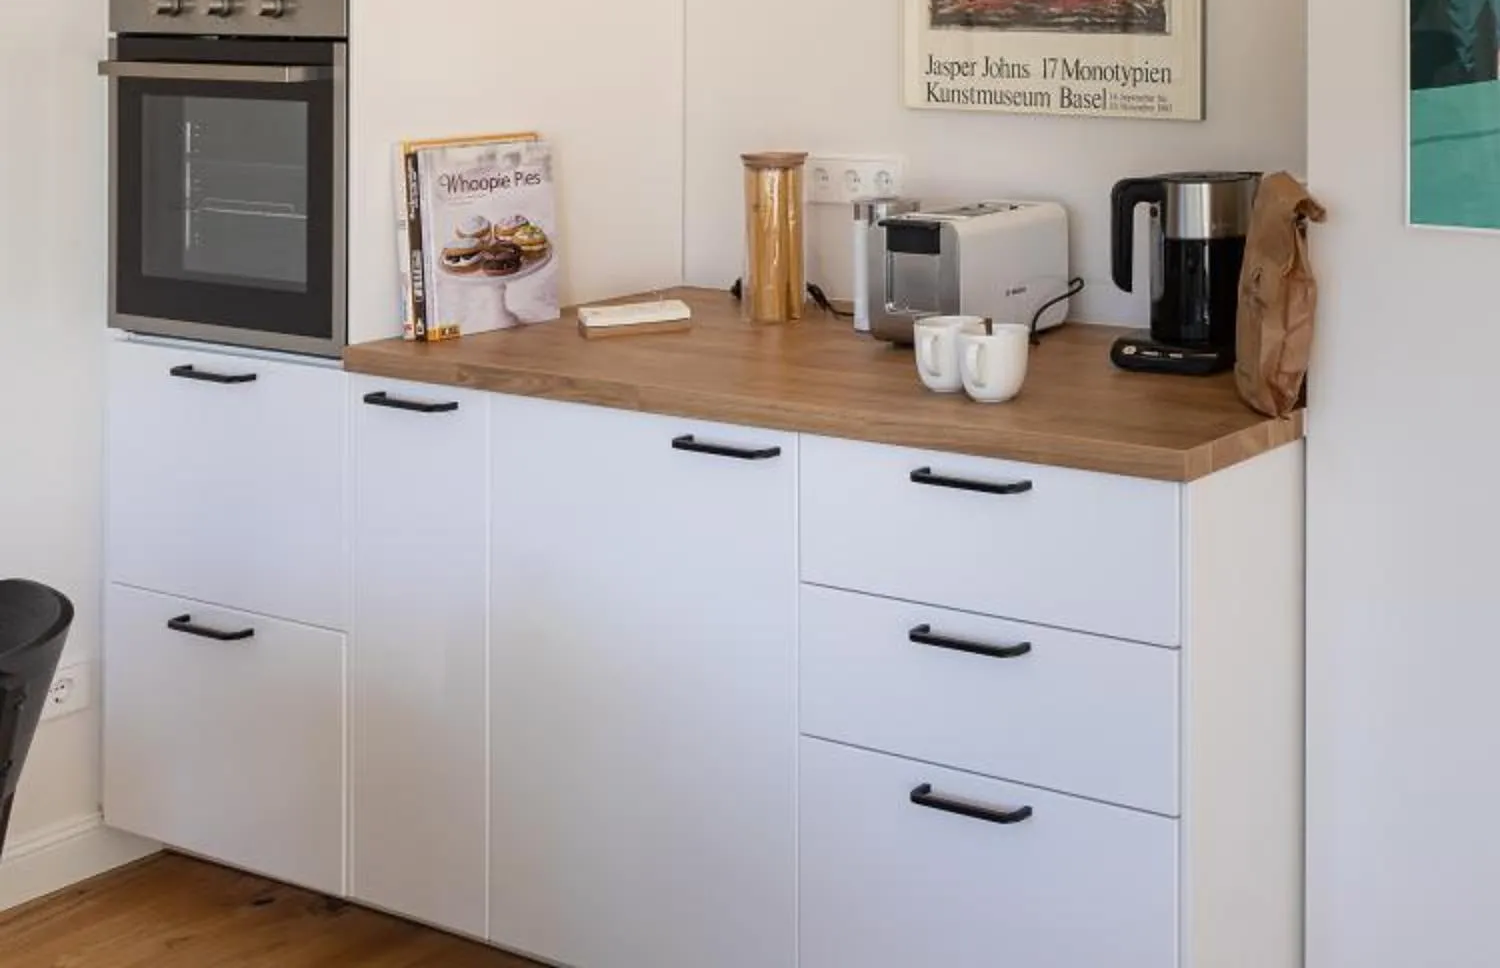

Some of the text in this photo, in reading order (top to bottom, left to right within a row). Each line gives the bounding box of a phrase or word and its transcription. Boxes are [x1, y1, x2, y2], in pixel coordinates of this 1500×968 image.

[925, 54, 1172, 87] Jasper Johns 17 Monotypien
[926, 82, 1051, 108] Kunstmuseum
[1060, 86, 1107, 110] Basel
[438, 171, 541, 194] Whoopie Pies
